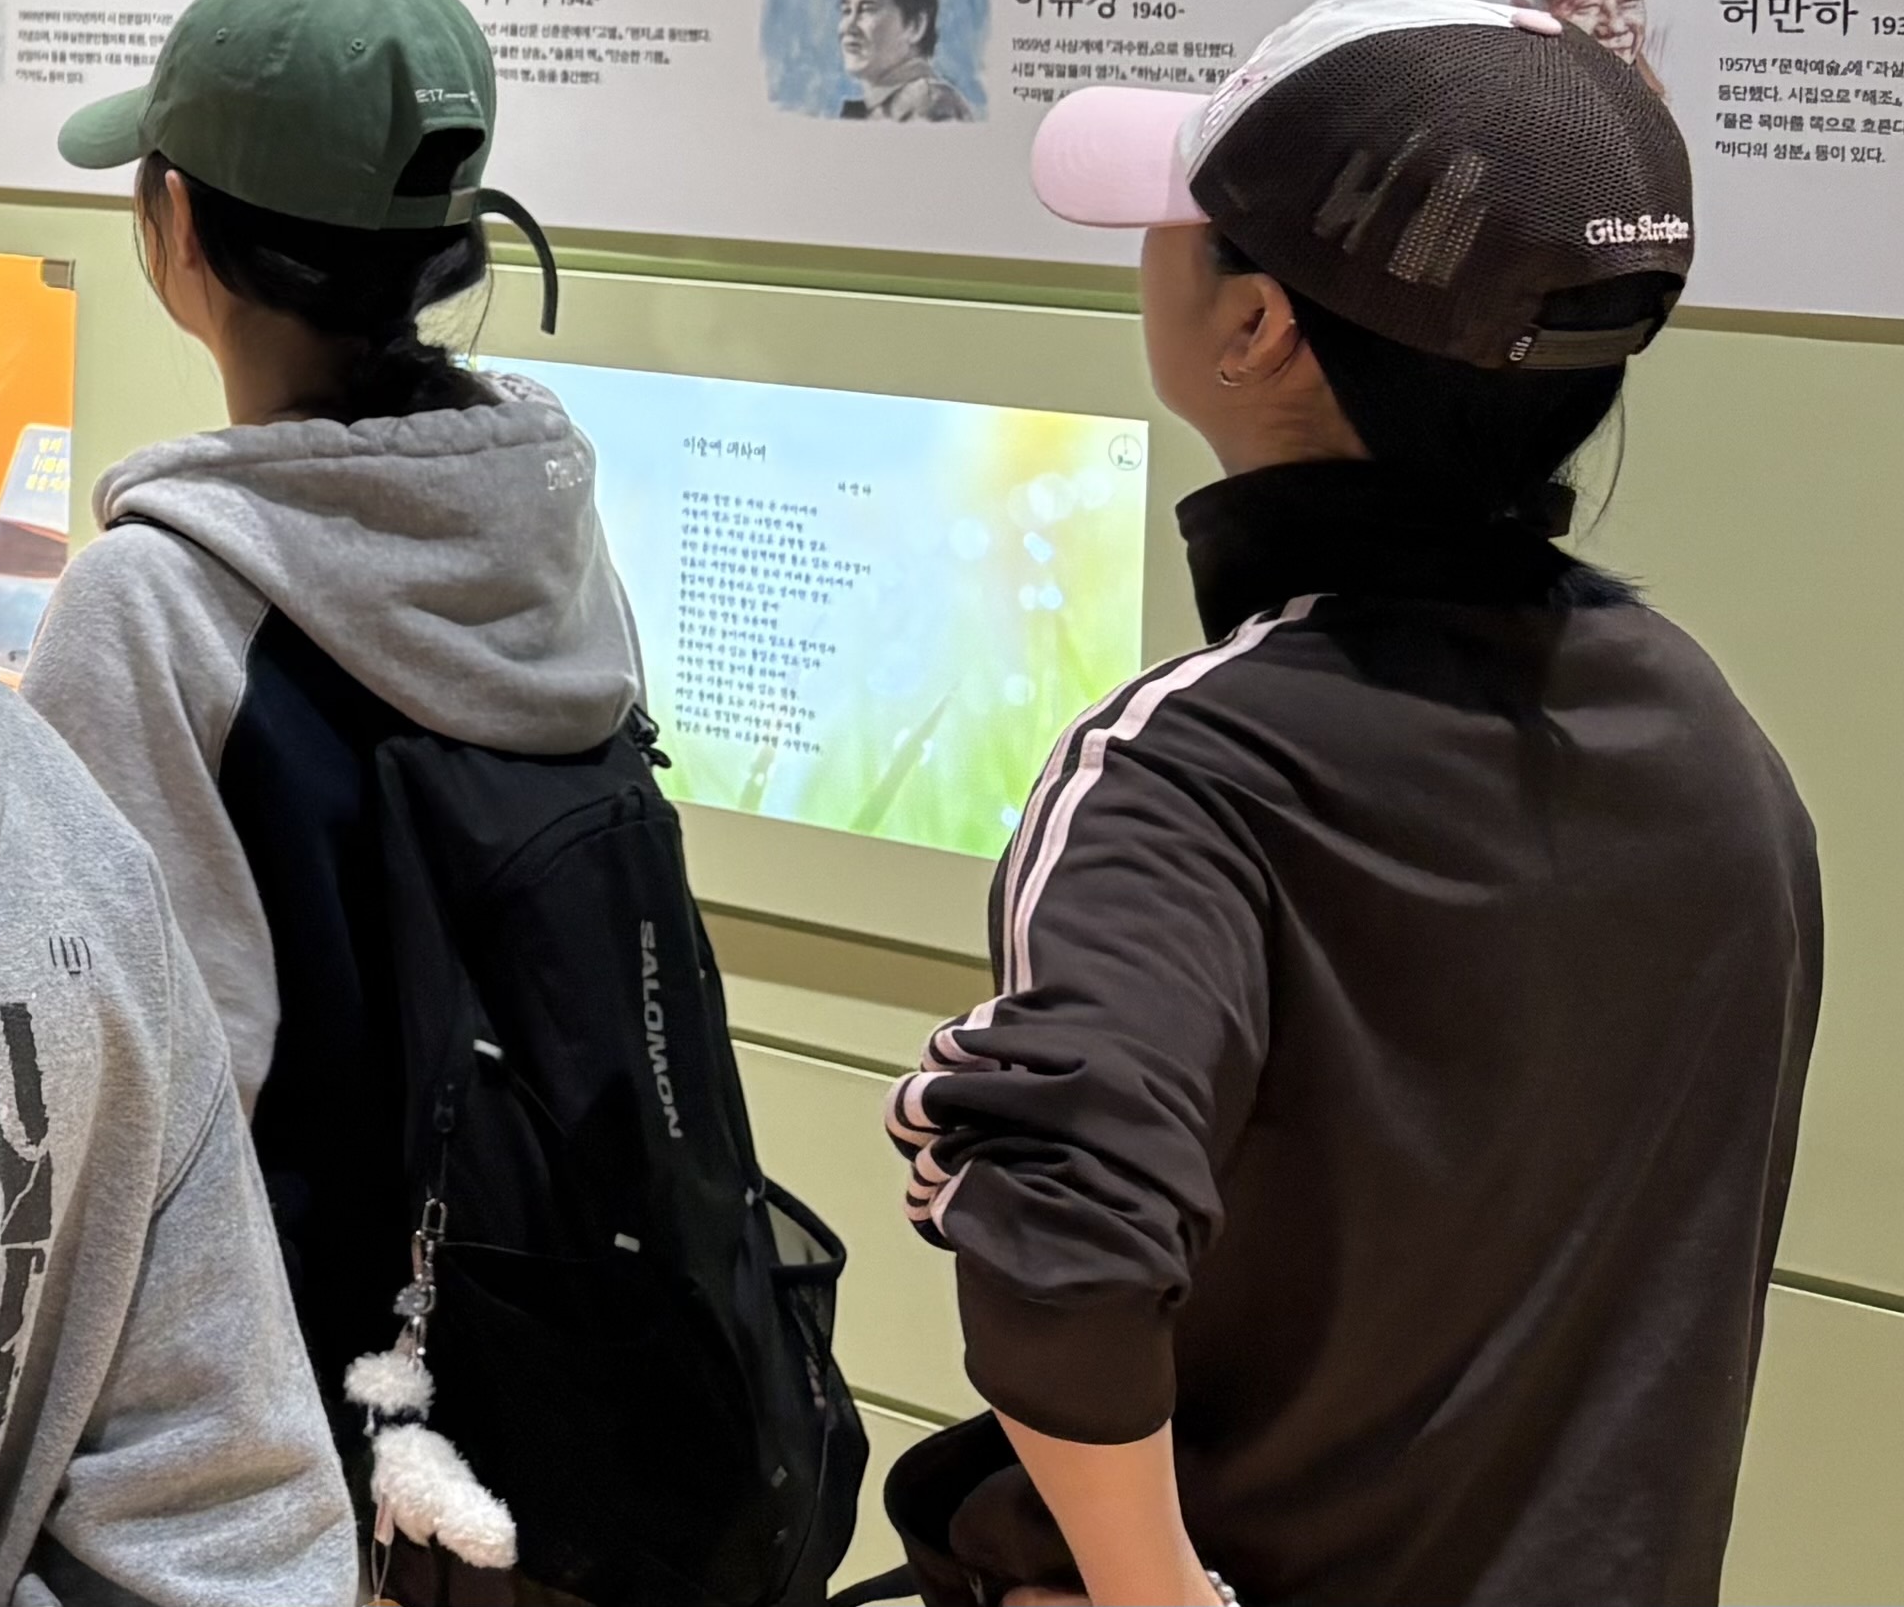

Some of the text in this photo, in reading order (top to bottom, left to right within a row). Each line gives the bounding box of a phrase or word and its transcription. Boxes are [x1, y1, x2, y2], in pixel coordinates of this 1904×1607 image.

[1132, 2, 1186, 20] 1940-
[1012, 61, 1034, 79] 시집
[1720, 57, 1767, 74] 1957년
[1719, 84, 1851, 105] 등단했다. 시집으로
[1810, 115, 1856, 134] 쪽으로
[1815, 143, 1845, 163] 등이
[1851, 145, 1885, 164] 있다.
[640, 920, 683, 1139] SALOMON
